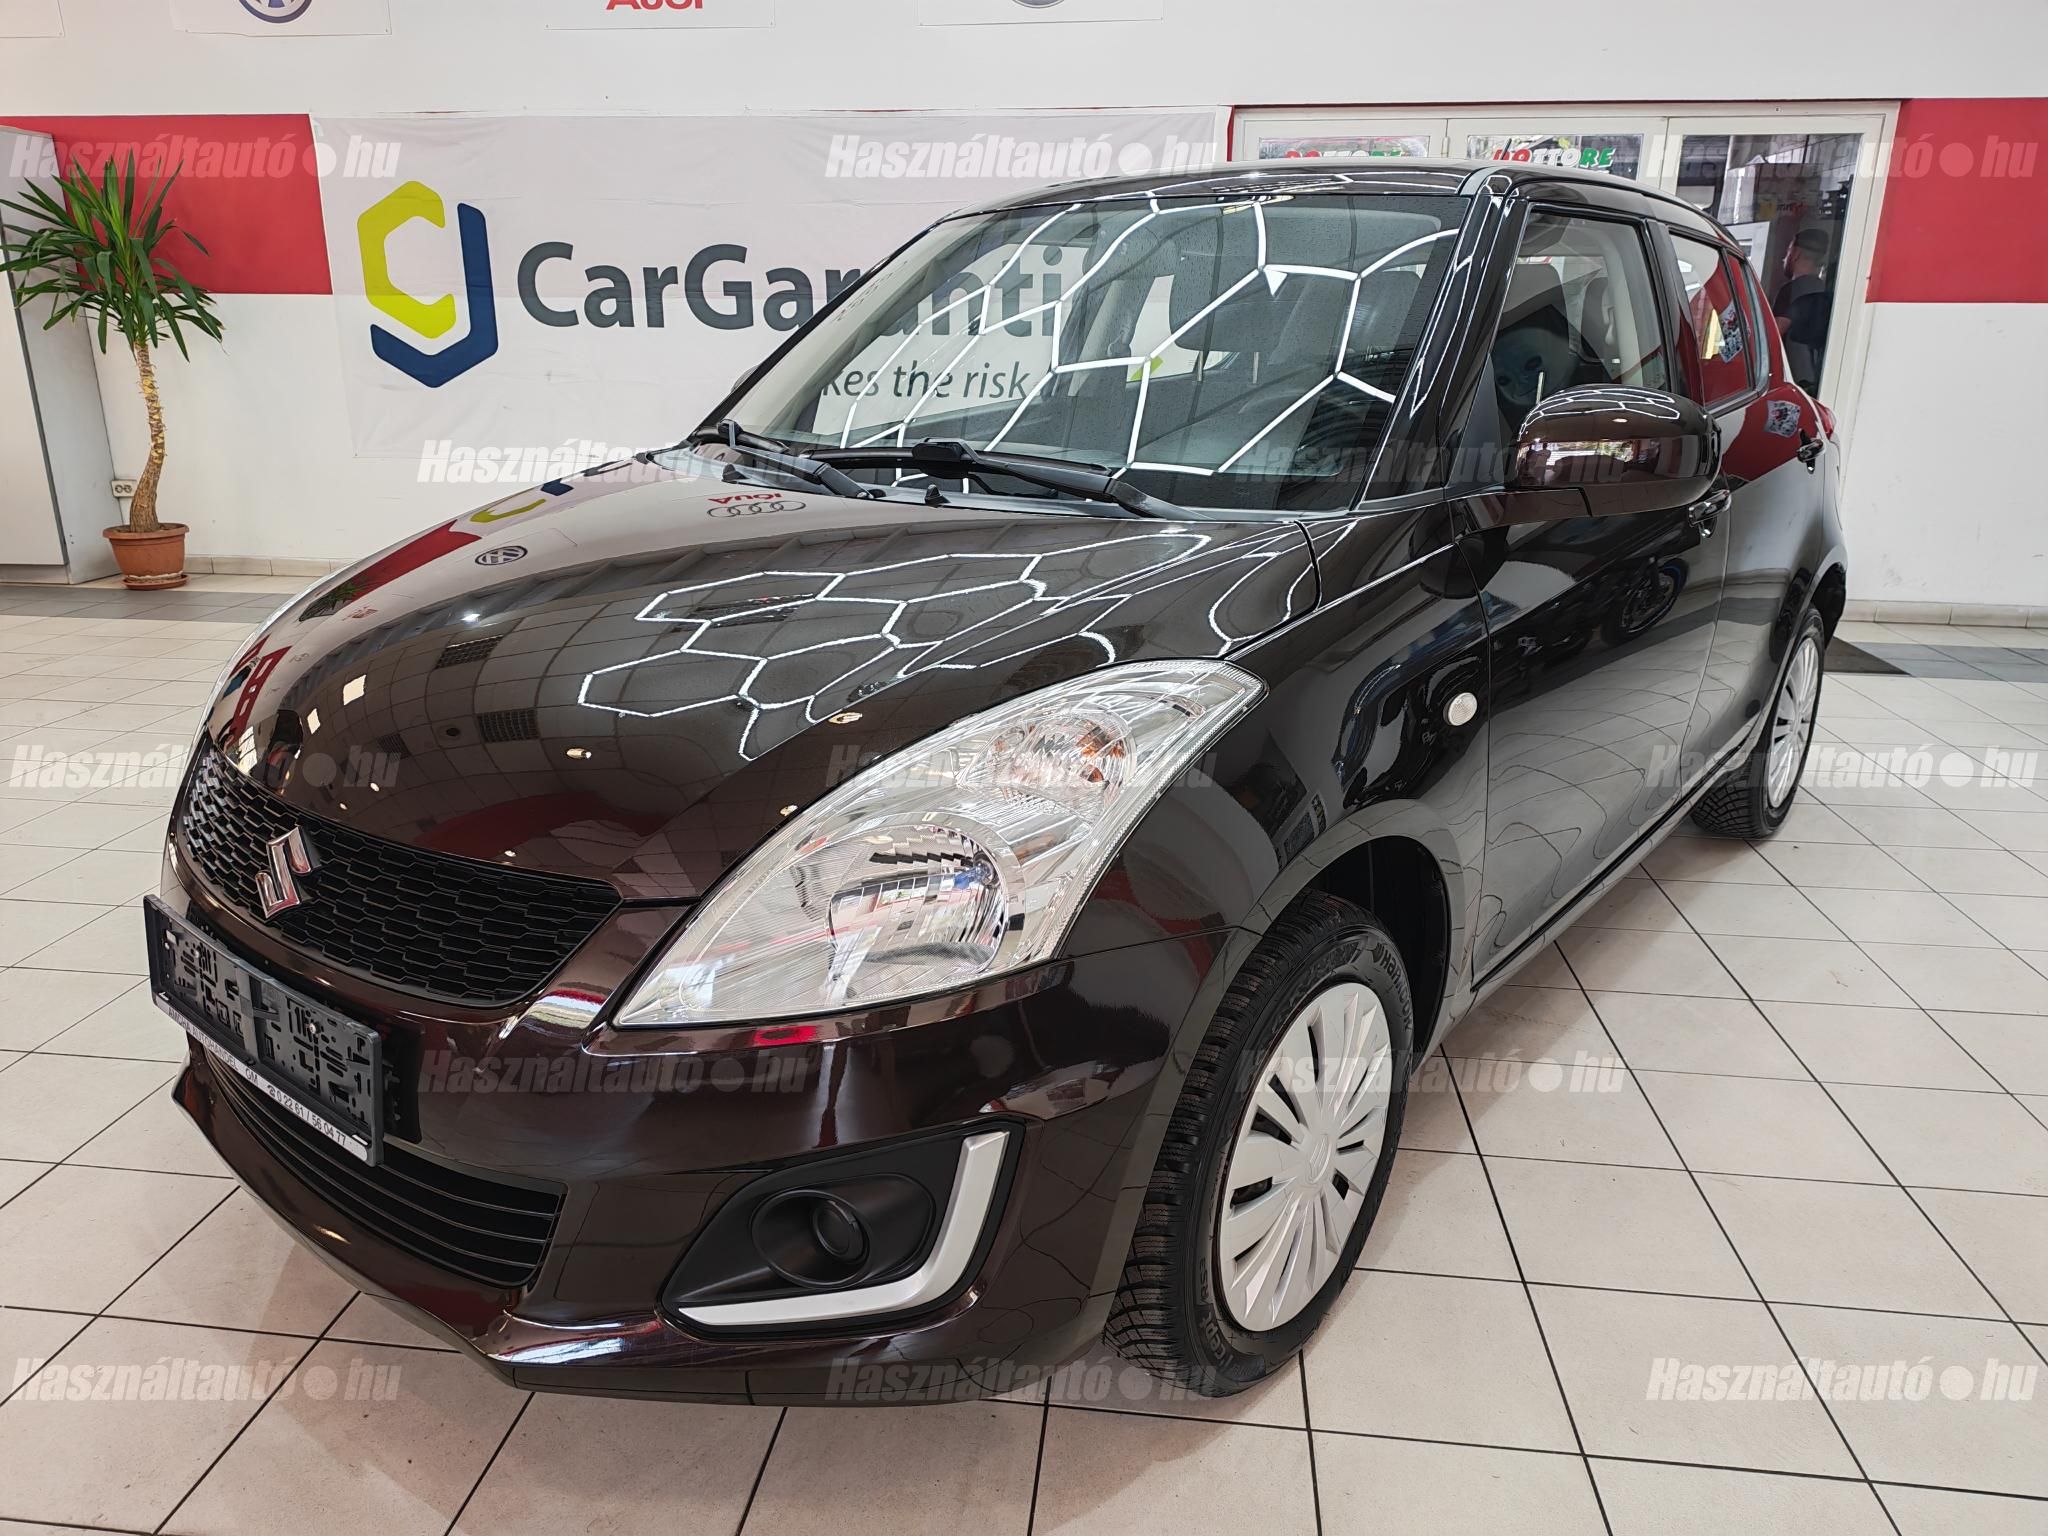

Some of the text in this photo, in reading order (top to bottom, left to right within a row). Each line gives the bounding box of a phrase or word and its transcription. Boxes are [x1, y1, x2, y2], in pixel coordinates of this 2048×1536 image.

[893, 360, 953, 398] the
[962, 361, 1032, 399] risk
[336, 1129, 346, 1146] 77
